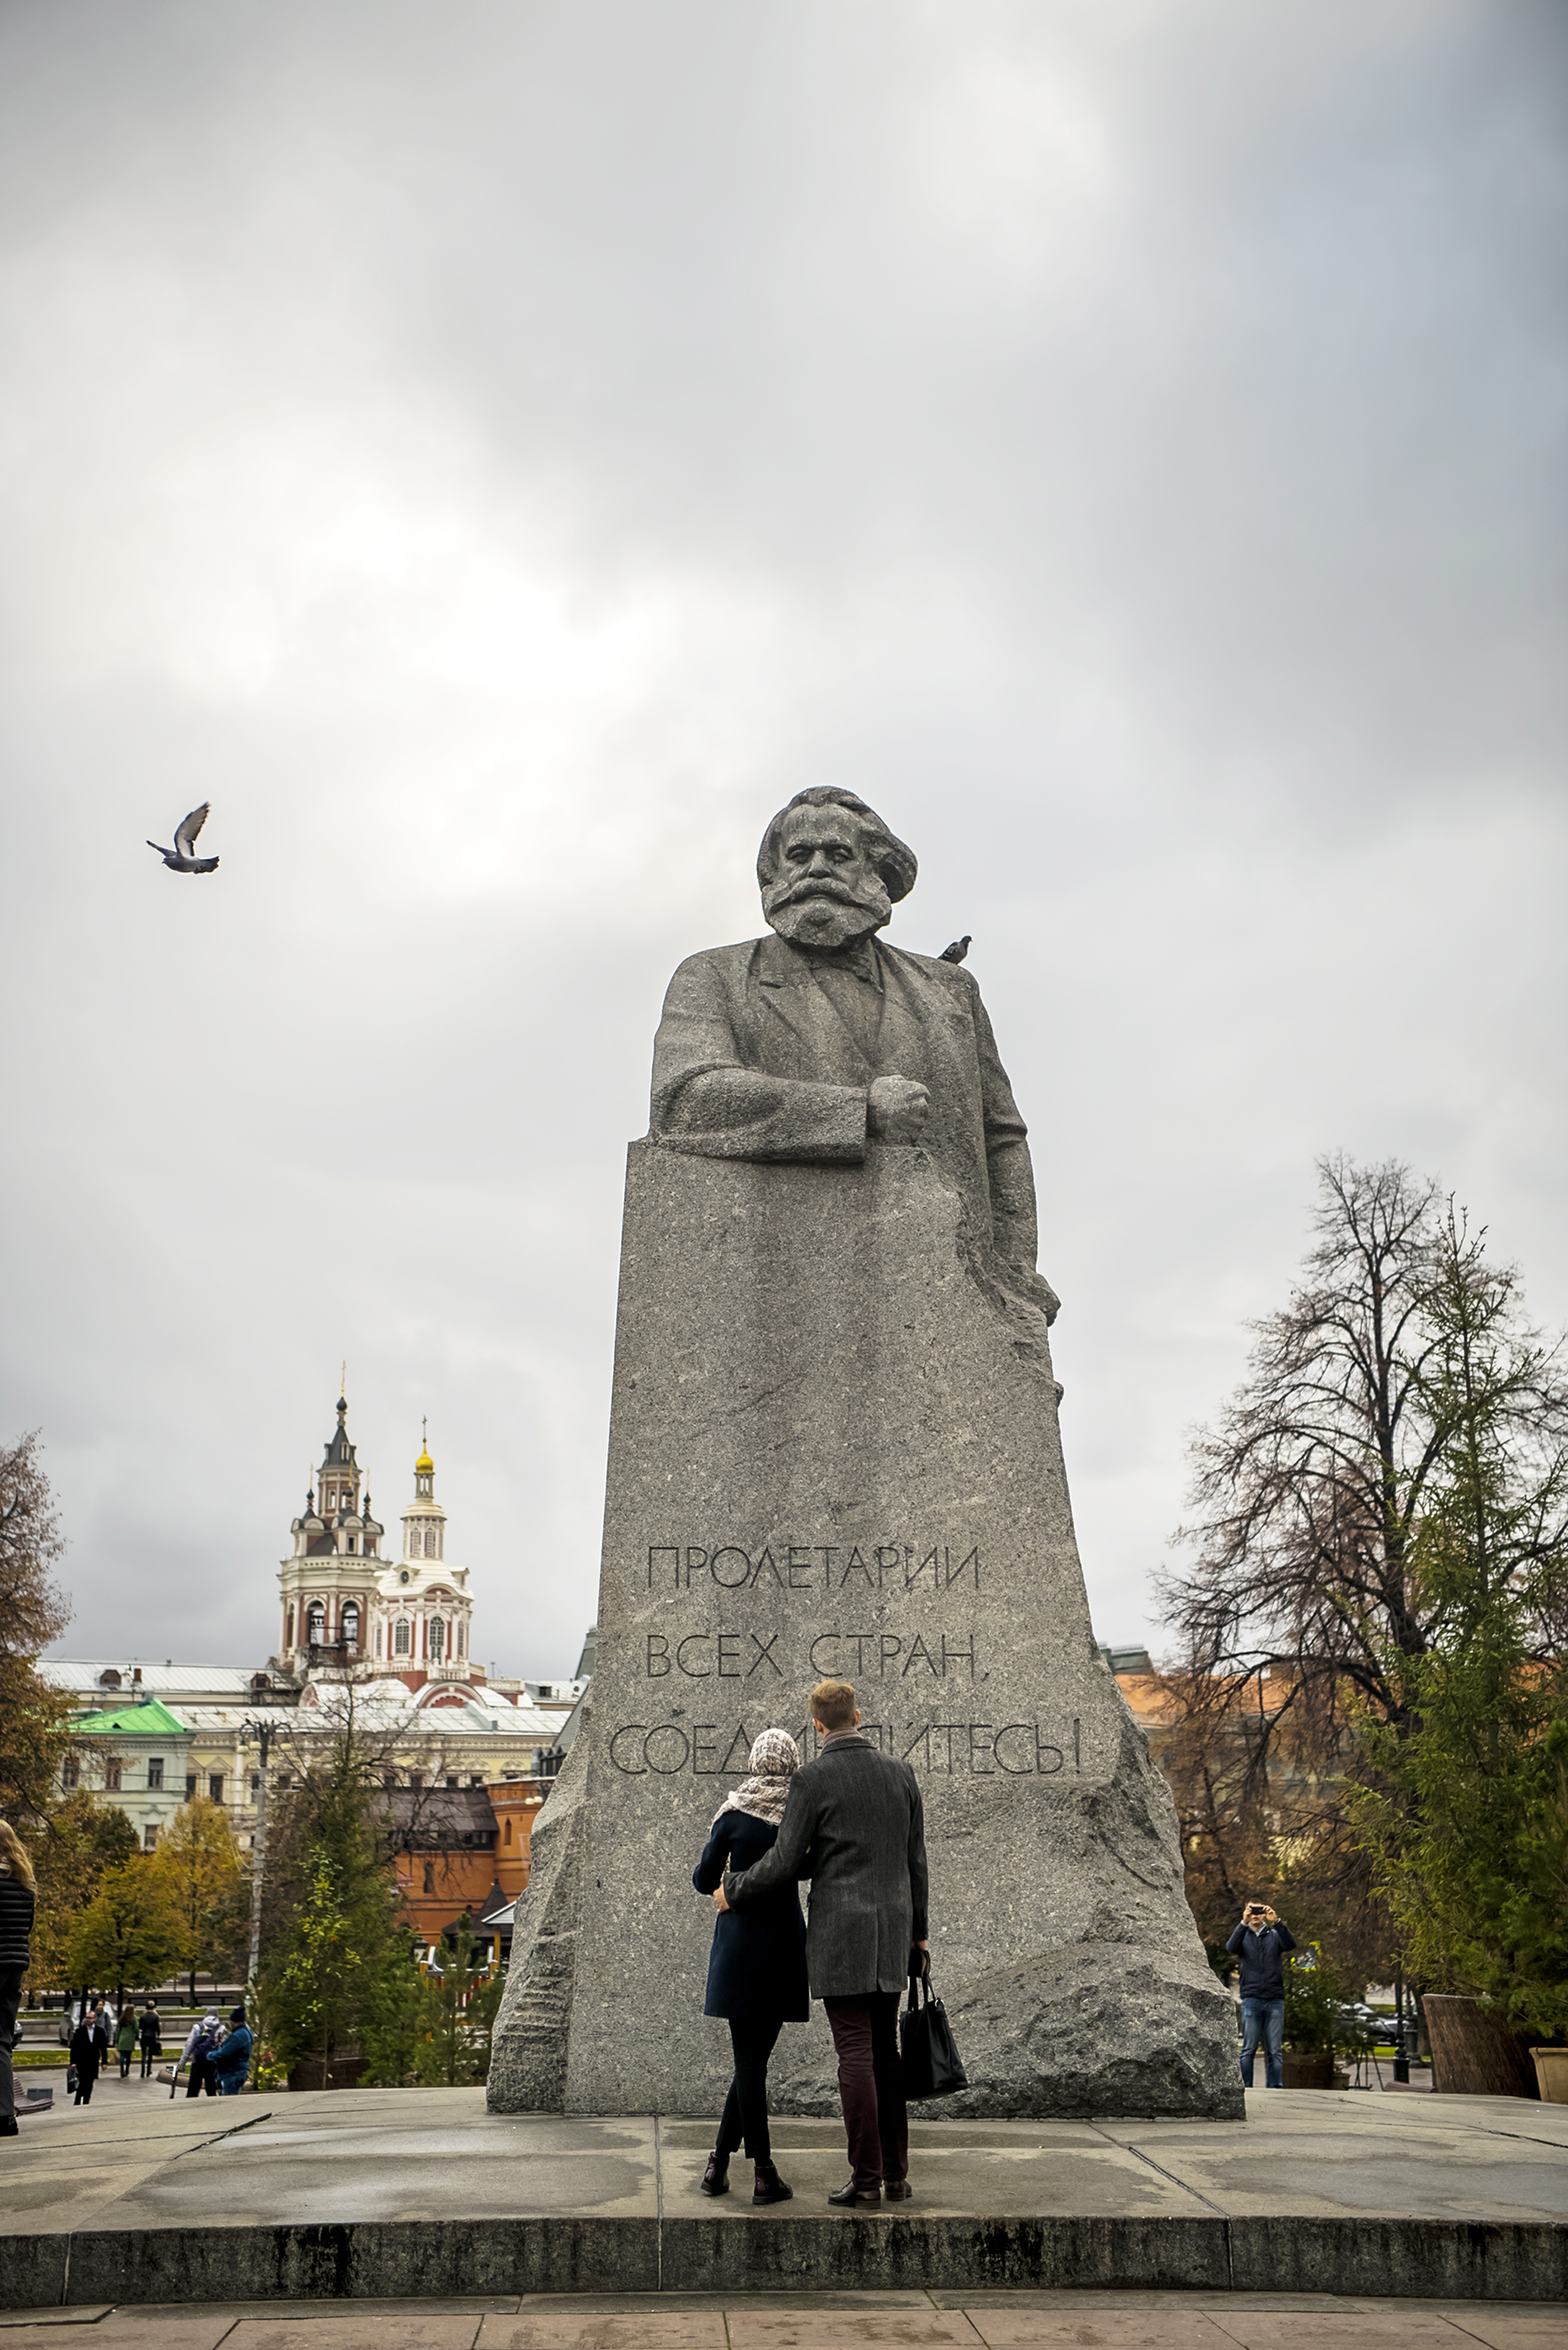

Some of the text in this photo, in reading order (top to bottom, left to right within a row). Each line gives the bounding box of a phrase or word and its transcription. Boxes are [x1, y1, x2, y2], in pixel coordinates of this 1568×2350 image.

[648, 1544, 980, 1589] ПРОЛЕТАРИИ
[647, 1633, 990, 1682] ВСЕХ СТРАН,
